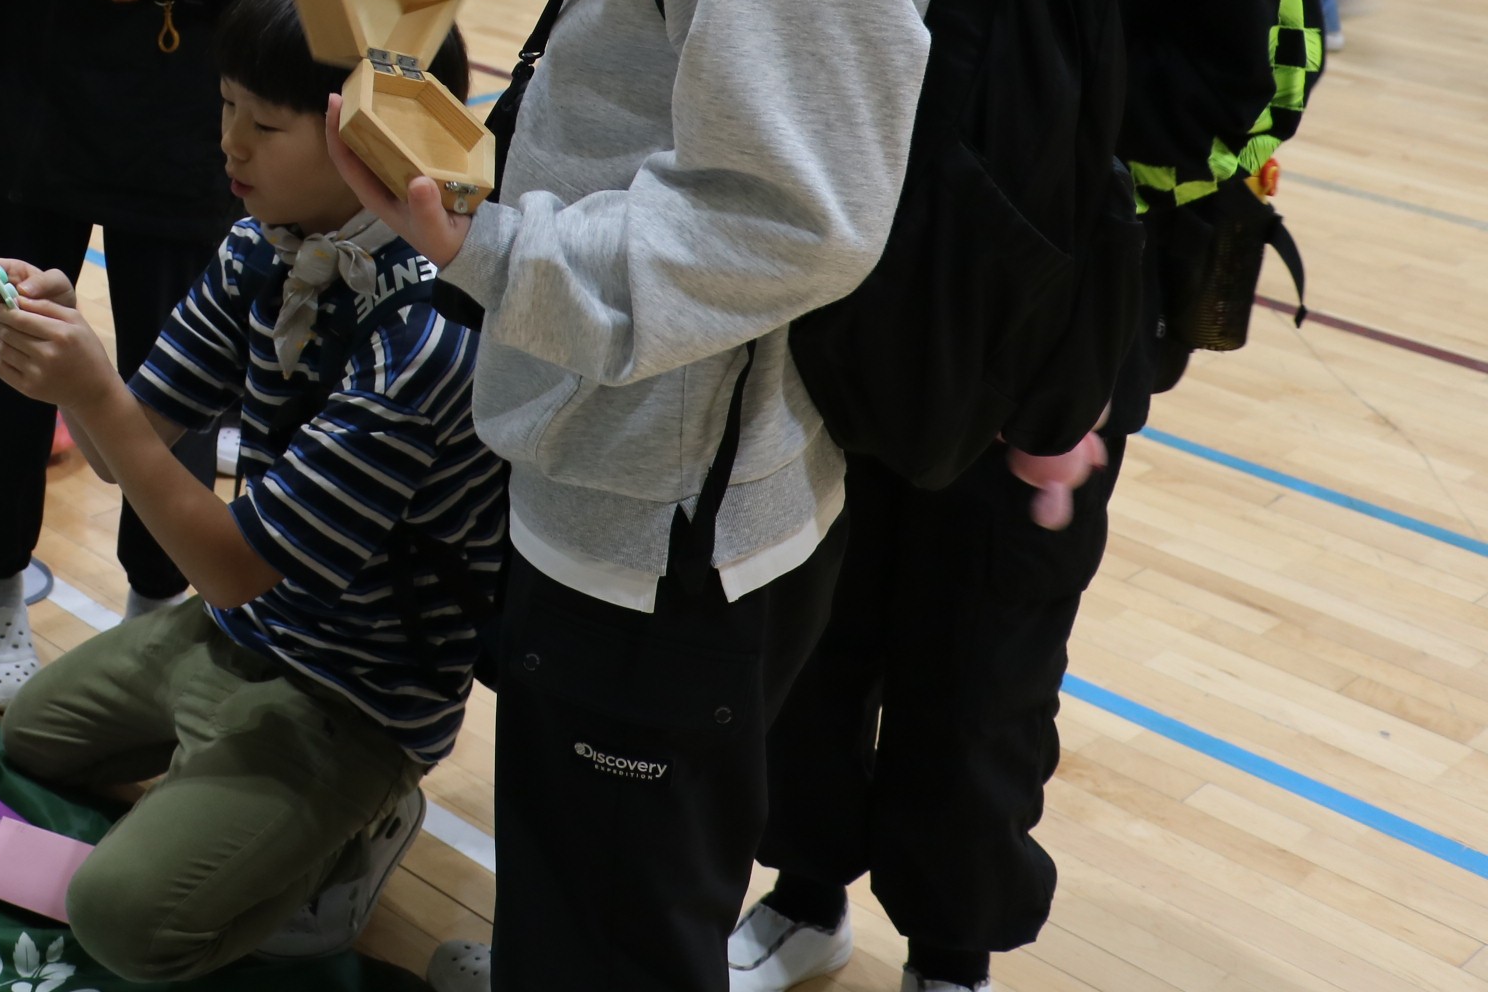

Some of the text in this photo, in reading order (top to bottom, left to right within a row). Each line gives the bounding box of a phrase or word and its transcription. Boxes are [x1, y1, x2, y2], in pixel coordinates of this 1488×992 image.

[353, 255, 438, 325] ENTE
[574, 742, 667, 778] Discovery
[594, 764, 653, 780] EXPEDITION
